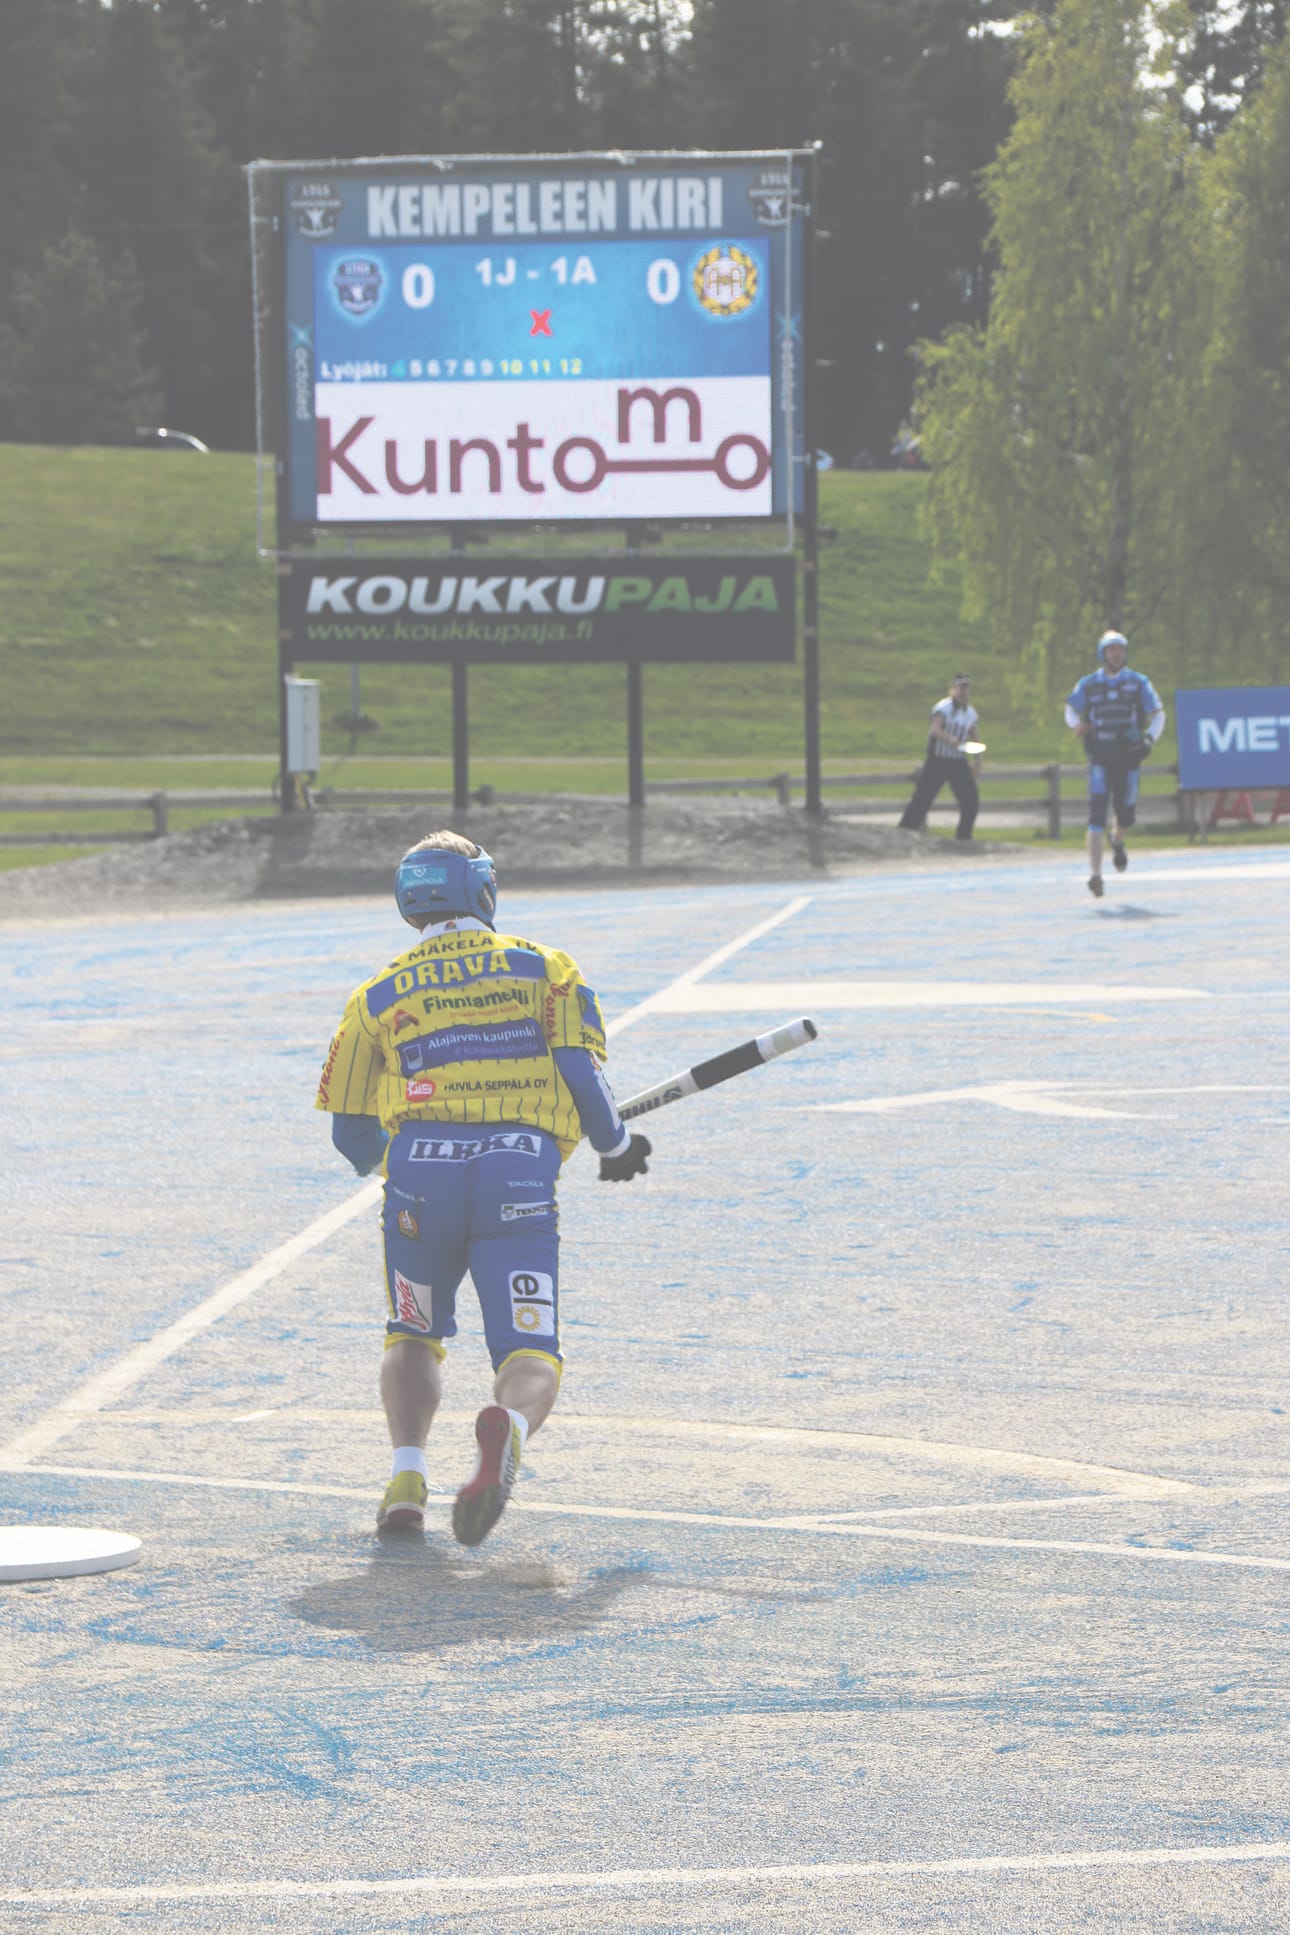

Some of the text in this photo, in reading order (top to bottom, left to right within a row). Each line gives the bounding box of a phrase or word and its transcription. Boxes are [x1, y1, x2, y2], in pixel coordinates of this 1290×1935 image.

[367, 176, 723, 237] KEMPELEEN KIRI
[402, 264, 436, 308] 0
[475, 257, 516, 286] 1J
[551, 255, 597, 285] 1A
[646, 258, 680, 304] 0
[445, 360, 458, 377] 7
[501, 358, 522, 375] 10
[530, 357, 550, 375] 11
[560, 357, 582, 375] 12
[317, 386, 771, 494] Kuntomo
[306, 576, 779, 615] KOUKKUPAJA
[306, 619, 593, 645] www.koukkupaja.fi
[394, 951, 512, 995] ORAVA
[428, 1025, 536, 1050] Alajärven kaupunki
[534, 1078, 548, 1089] OY
[412, 1134, 537, 1160] ILKKA
